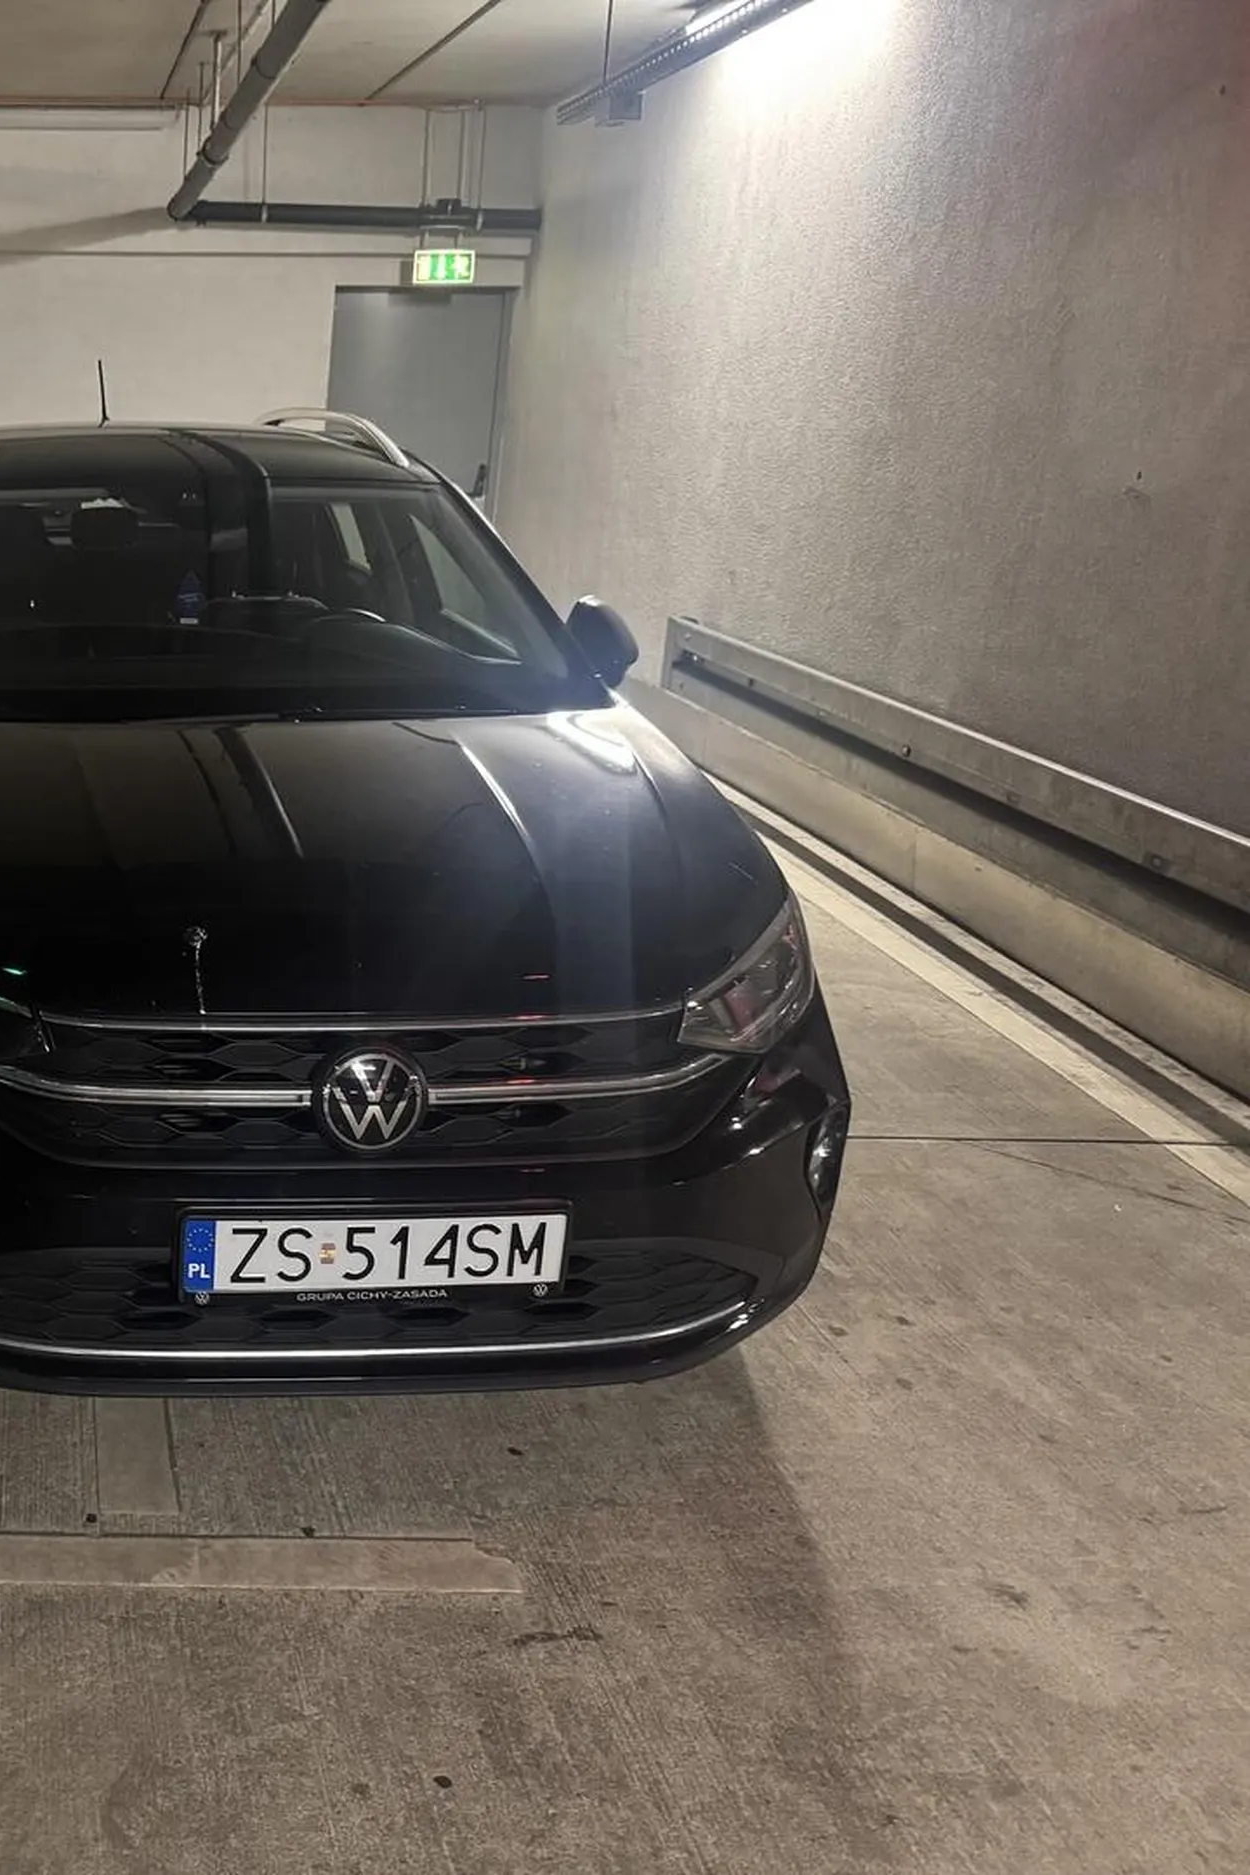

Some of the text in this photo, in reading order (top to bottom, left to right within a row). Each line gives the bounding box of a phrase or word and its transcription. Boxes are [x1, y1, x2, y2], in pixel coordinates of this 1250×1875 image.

[230, 1222, 548, 1284] ZS 514SM
[188, 1264, 211, 1279] PL
[296, 1288, 448, 1302] GRUPA CICHY-ZASADA
